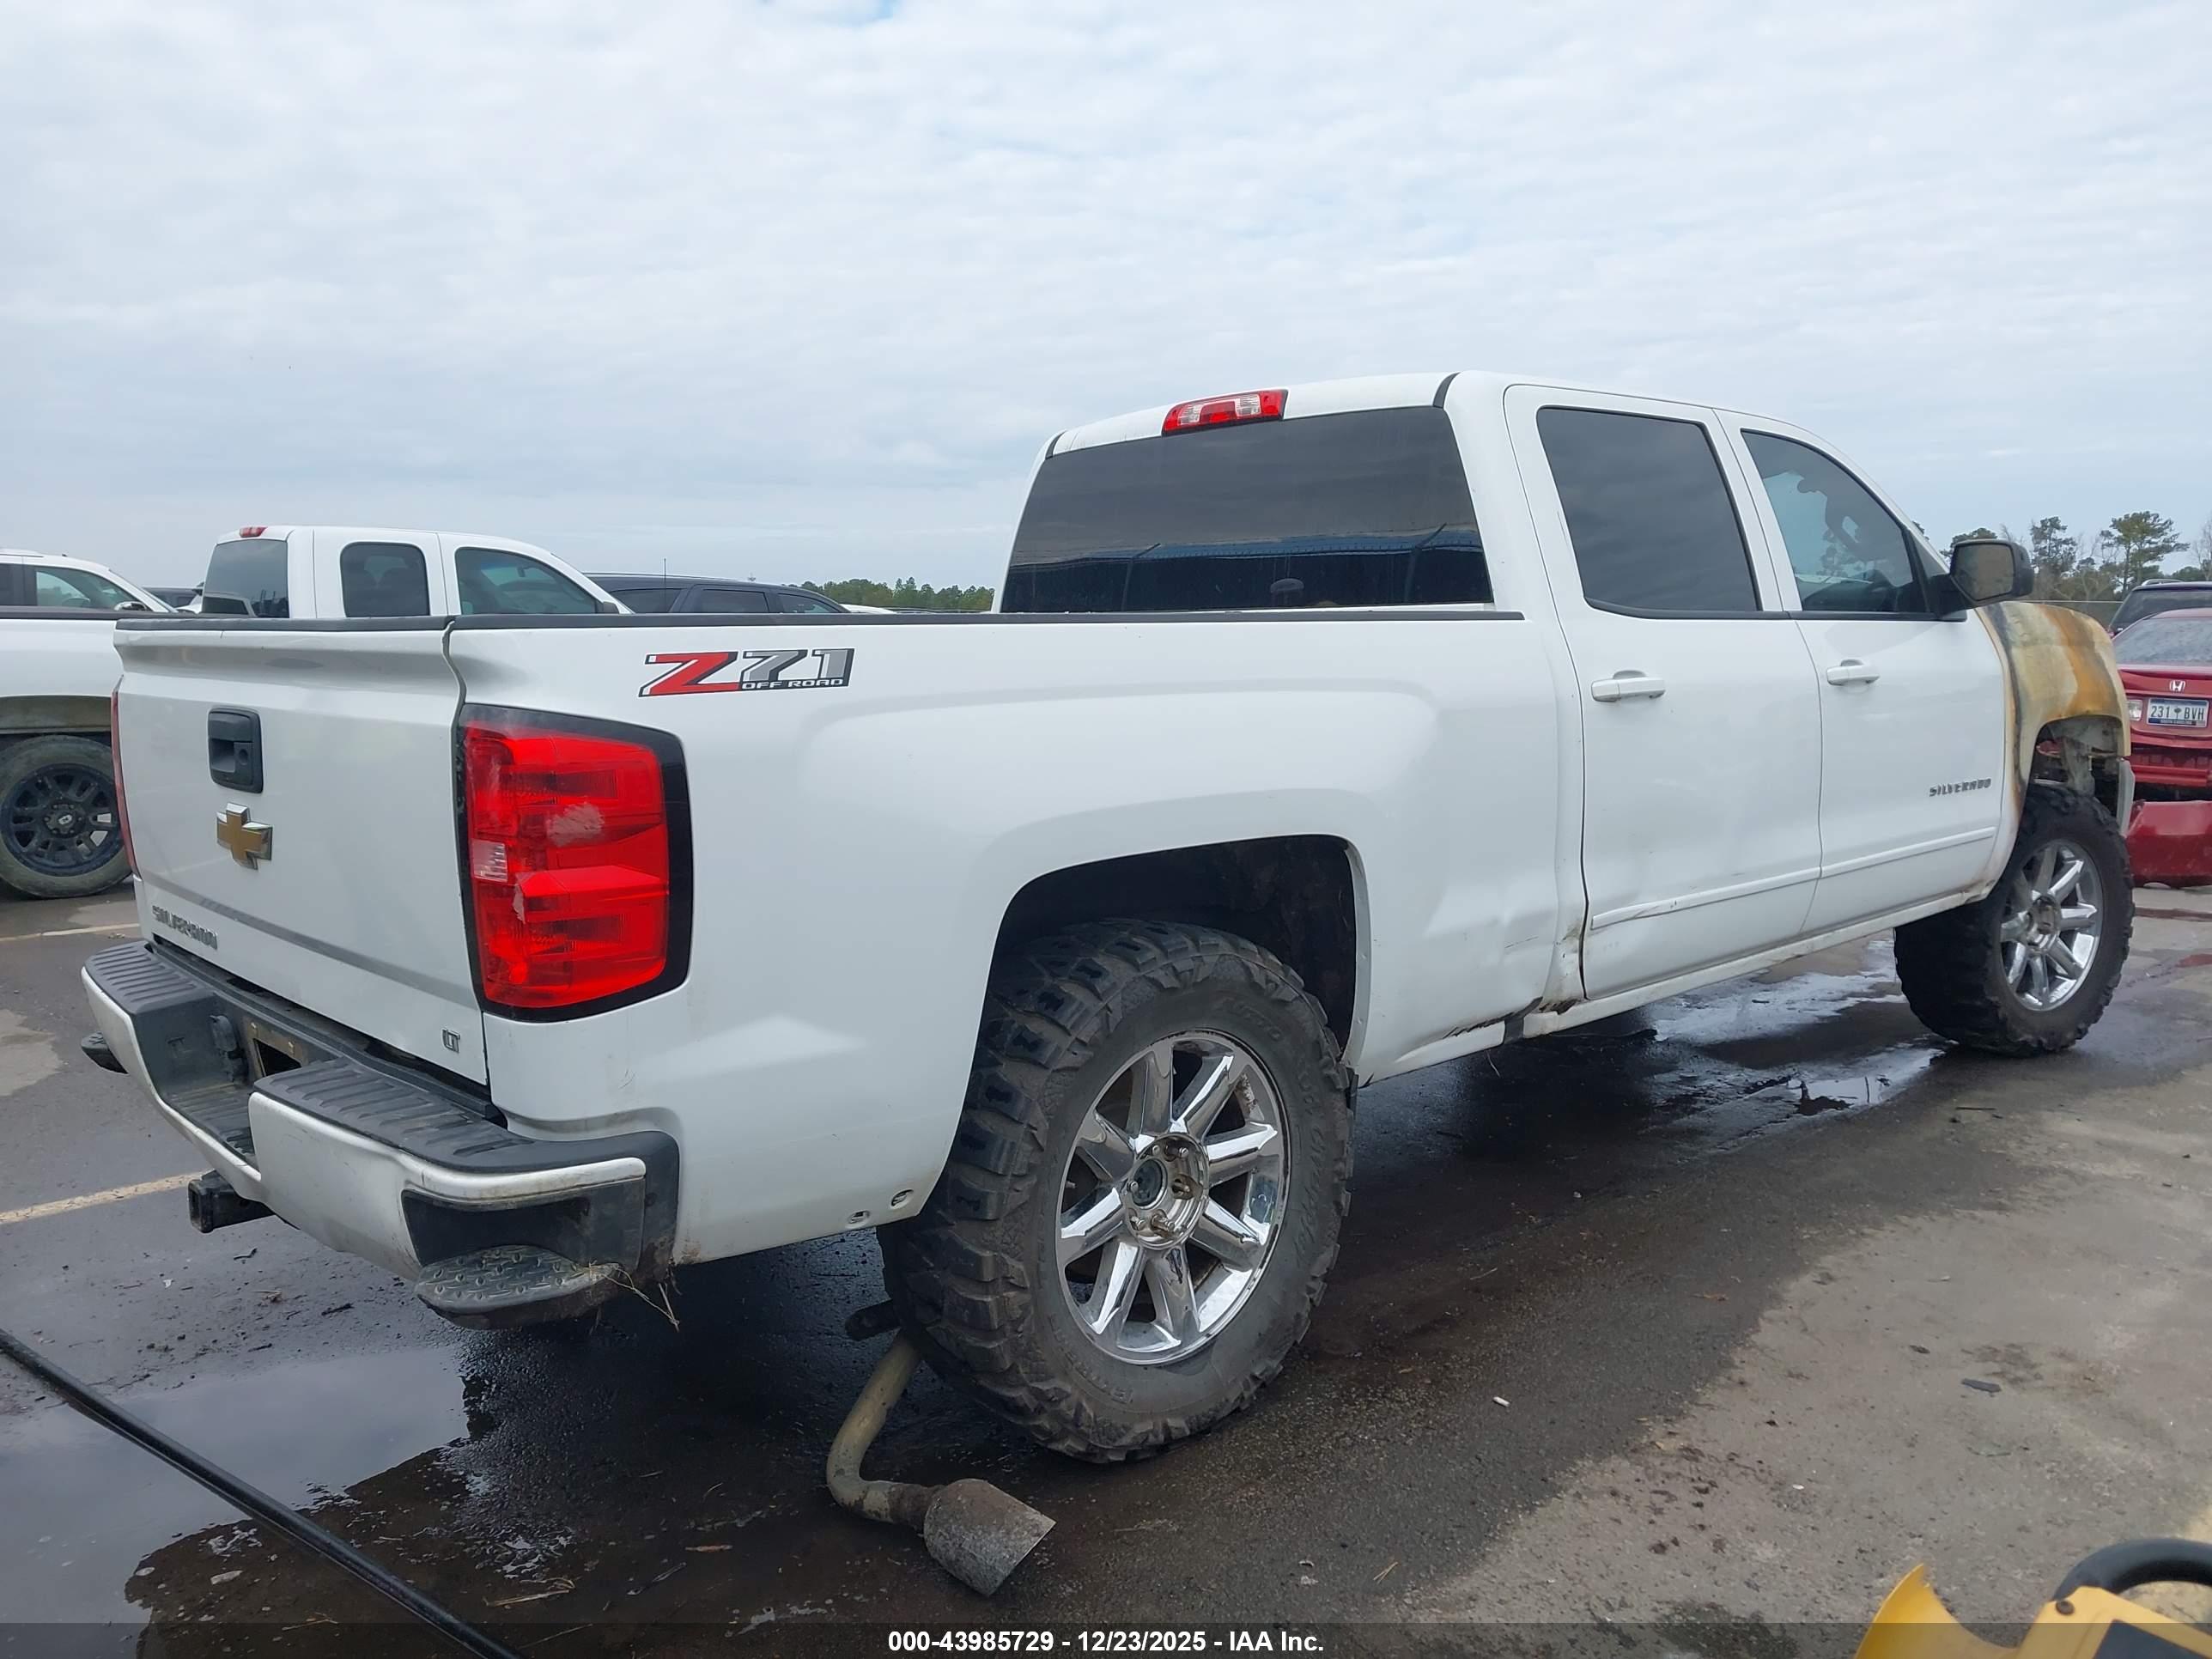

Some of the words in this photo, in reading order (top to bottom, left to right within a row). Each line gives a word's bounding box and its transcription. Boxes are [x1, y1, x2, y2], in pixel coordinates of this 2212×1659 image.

[639, 648, 854, 696] Z71
[741, 681, 782, 690] OFF
[787, 678, 843, 688] ROAD
[2150, 705, 2171, 718] 231
[2184, 707, 2205, 720] BVH
[441, 1029, 461, 1054] LT
